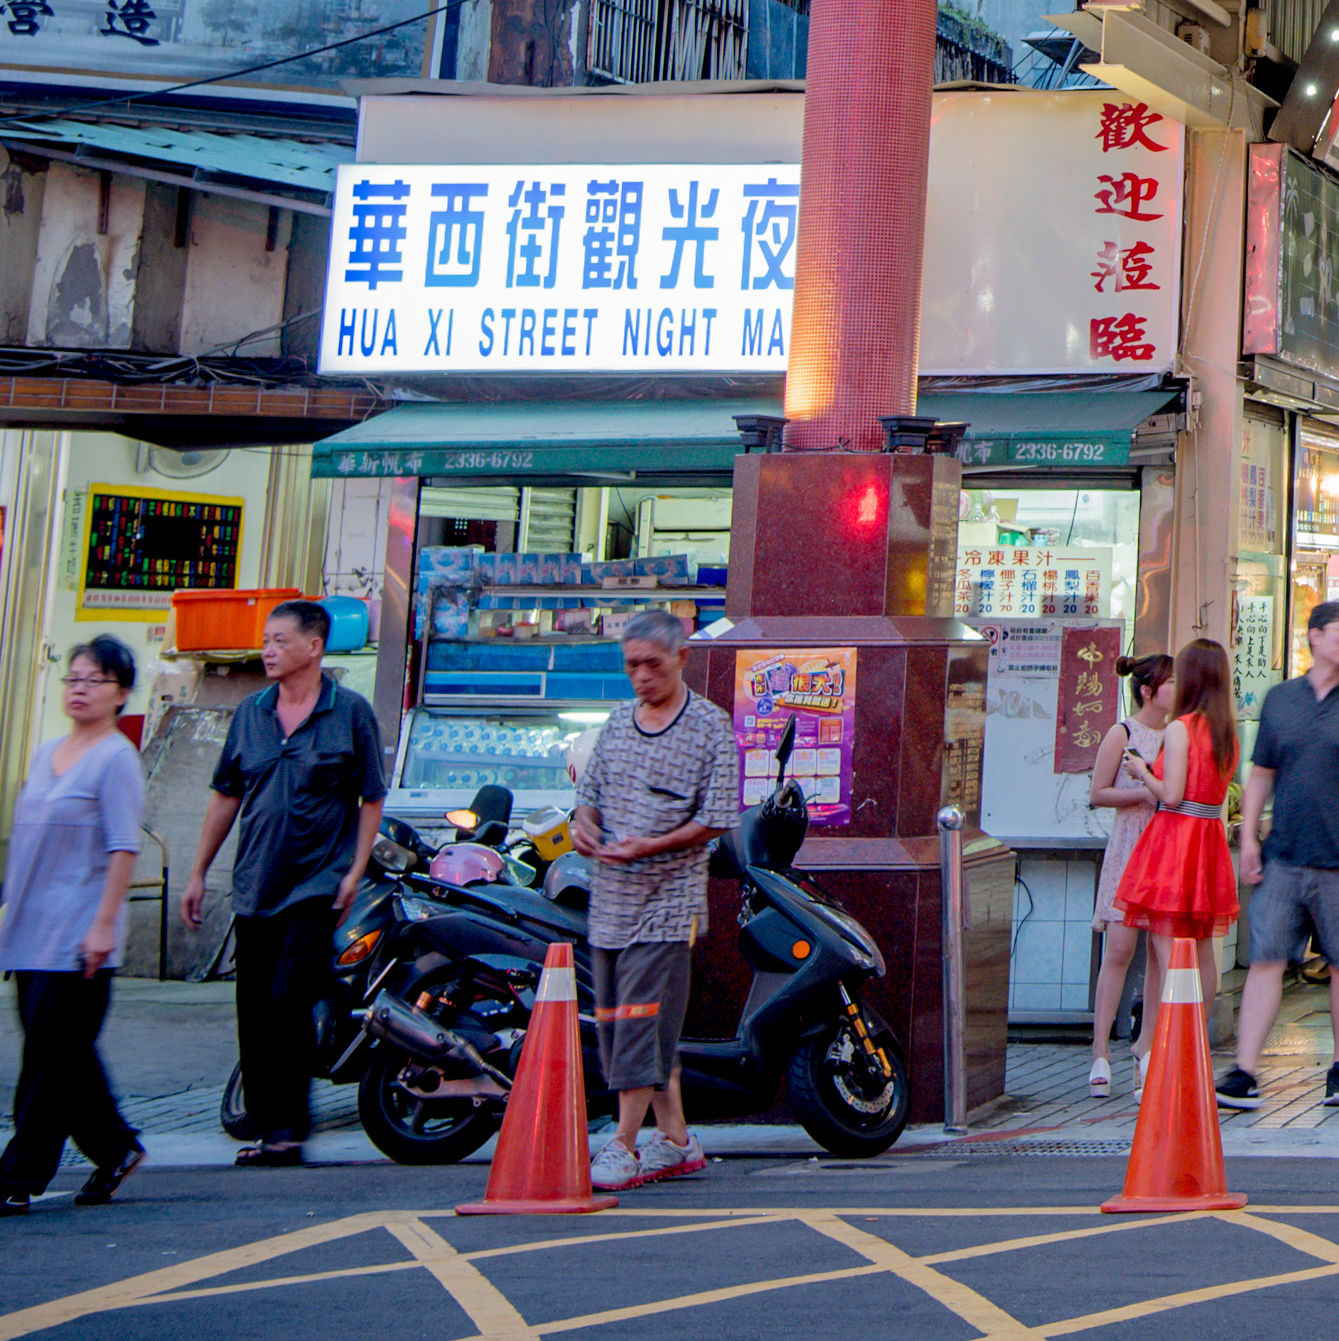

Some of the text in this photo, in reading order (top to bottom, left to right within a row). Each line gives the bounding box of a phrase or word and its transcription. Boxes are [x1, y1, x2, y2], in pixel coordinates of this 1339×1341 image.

[345, 178, 800, 291] 華西街觀光夜
[1089, 102, 1169, 361] 歡迎蒞臨
[337, 308, 398, 357] HUA
[424, 308, 453, 357] XI
[479, 307, 599, 357] STREET
[622, 308, 718, 357] NIGHT
[1015, 442, 1105, 461] 2336-6792
[337, 451, 533, 476] 華新帆布 2336-6792
[964, 550, 1053, 566] 冷凍果汁
[956, 604, 969, 614] 20
[979, 604, 992, 613] 20
[1022, 604, 1035, 613] 20
[1042, 604, 1056, 614] 20
[1063, 604, 1077, 614] 20
[1085, 605, 1098, 614] 20
